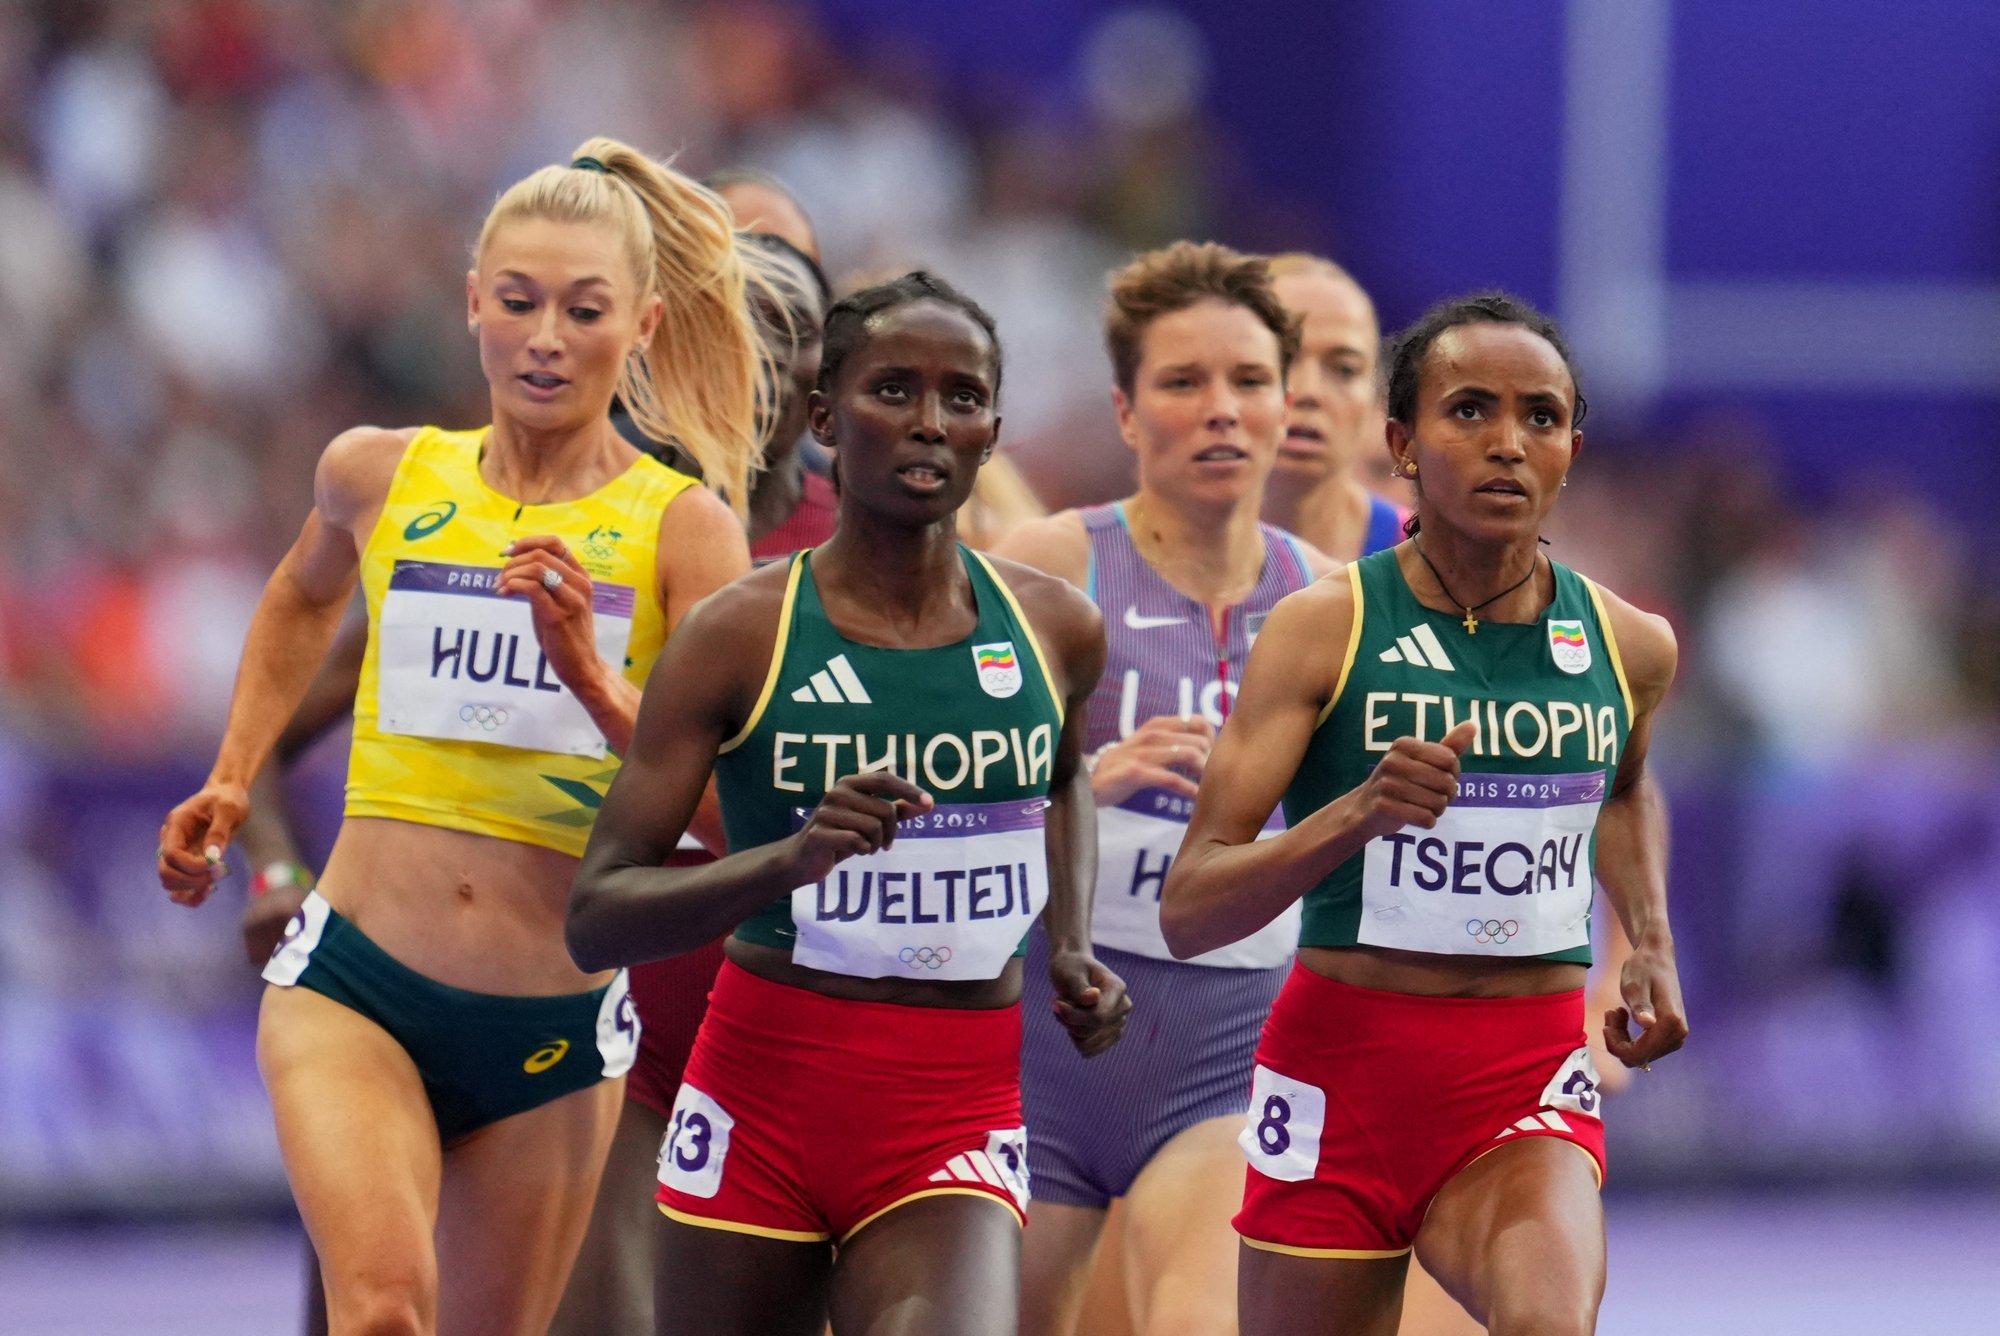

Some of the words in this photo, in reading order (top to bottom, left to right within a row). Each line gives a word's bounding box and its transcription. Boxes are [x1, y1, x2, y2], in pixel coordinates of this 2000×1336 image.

[447, 571, 493, 589] PARI
[431, 626, 561, 692] HULL
[773, 724, 1052, 792] ETHIOPIA
[1364, 692, 1618, 765] ETHIOPIA
[932, 813, 988, 829] 2024
[1456, 782, 1498, 798] ARIS
[1507, 783, 1560, 799] 2024
[815, 862, 1031, 925] WELTEJI
[1382, 834, 1583, 896] TSEGAY
[668, 1108, 711, 1172] 13
[1257, 1095, 1291, 1156] 8
